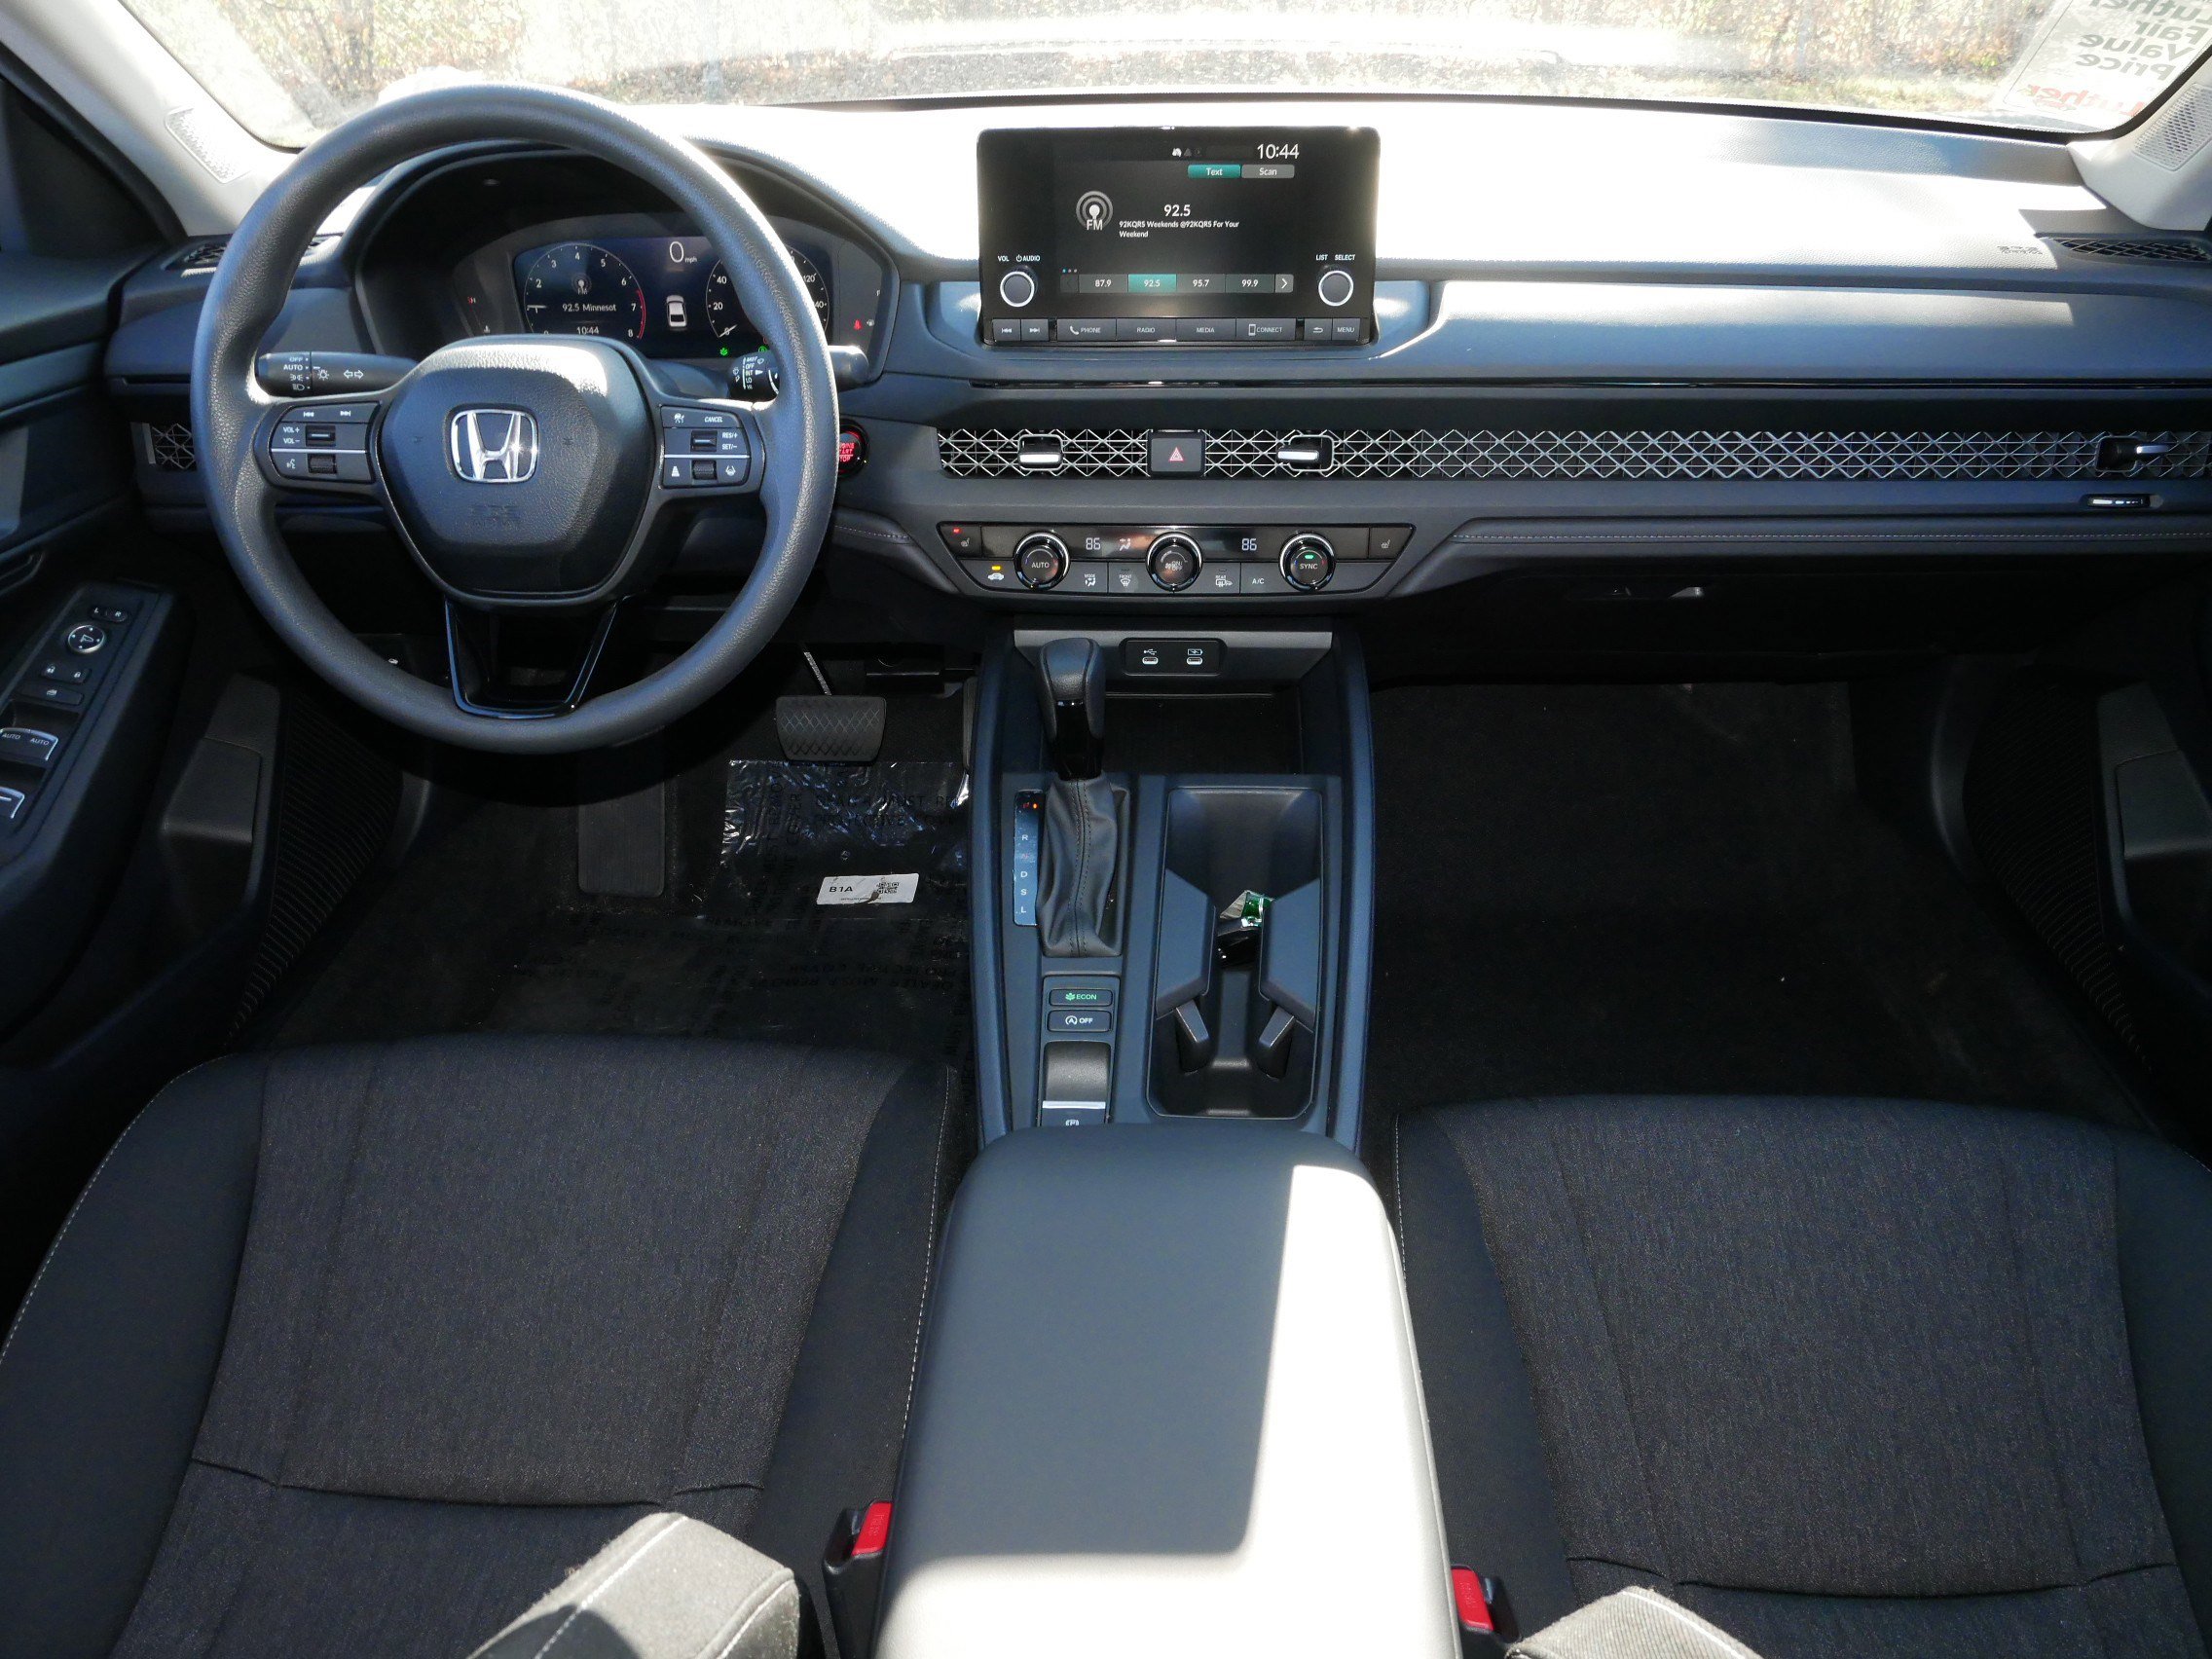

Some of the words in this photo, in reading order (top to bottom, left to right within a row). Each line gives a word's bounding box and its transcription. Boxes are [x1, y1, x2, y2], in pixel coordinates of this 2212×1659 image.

[1257, 143, 1300, 160] 10:44
[1205, 166, 1223, 176] Text
[1259, 166, 1277, 176] Scan
[1163, 203, 1191, 217] 92.5
[1087, 219, 1103, 231] FM
[574, 252, 580, 261] 4
[670, 240, 684, 263] 0
[551, 259, 557, 269] 3
[601, 258, 607, 268] 5
[535, 278, 542, 288] 2
[621, 276, 627, 286] 6
[717, 276, 727, 284] 40
[1095, 279, 1112, 288] 87.9
[1144, 279, 1161, 288] 92.5
[1193, 278, 1209, 287] 95.7
[1241, 278, 1259, 287] 99.9
[562, 303, 580, 313] 92.5
[582, 303, 617, 312] Minnesot
[631, 303, 637, 312] 7
[713, 302, 723, 311] 20
[576, 326, 600, 335] 10:44
[1, 732, 21, 741] AUTO
[30, 737, 50, 747] AUTO
